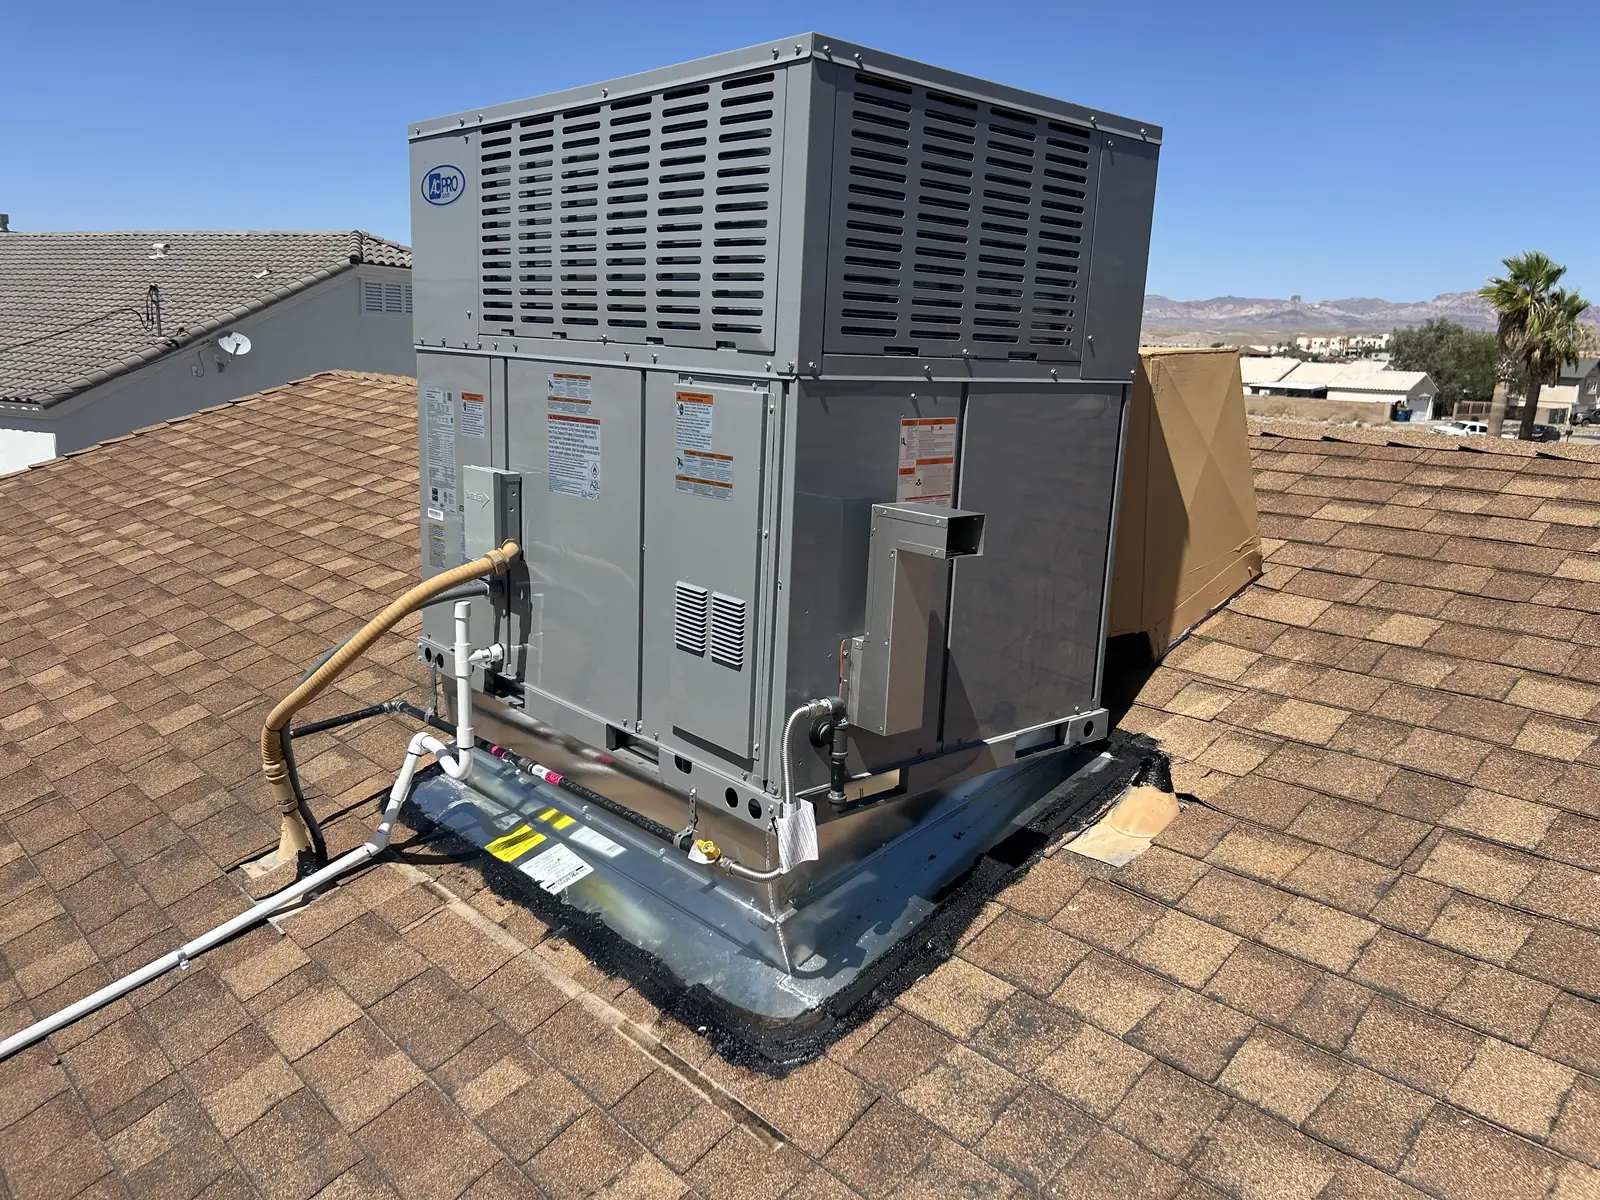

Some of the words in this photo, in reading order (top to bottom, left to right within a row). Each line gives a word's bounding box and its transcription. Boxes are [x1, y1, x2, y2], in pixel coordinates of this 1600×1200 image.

[590, 480, 600, 490] A2L
[585, 791, 621, 811] MEXICO
[624, 811, 664, 833] MEXICO
